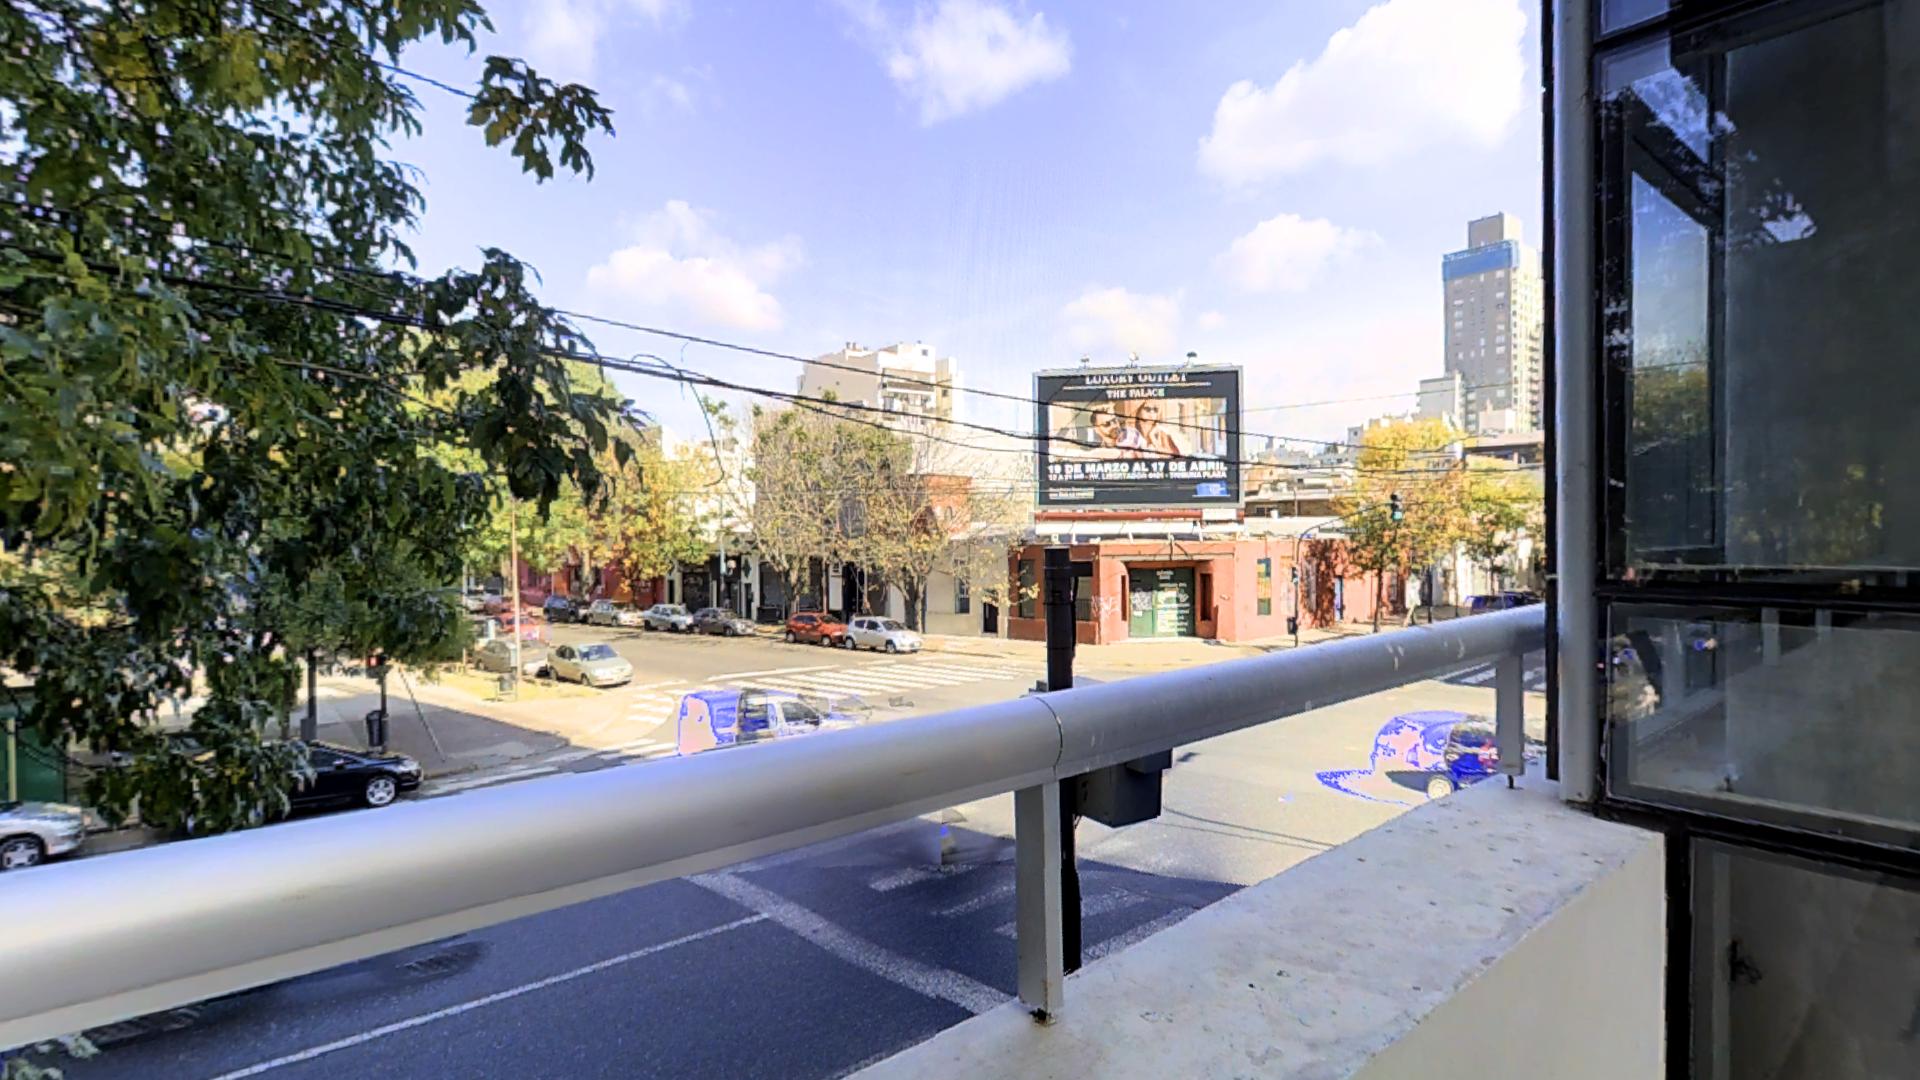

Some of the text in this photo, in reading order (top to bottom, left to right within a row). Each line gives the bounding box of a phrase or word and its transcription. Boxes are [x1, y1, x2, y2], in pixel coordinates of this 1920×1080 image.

[1085, 372, 1187, 385] LUXURY OUTLET
[1105, 387, 1165, 399] THE PALACE
[1064, 463, 1083, 474] DE
[1085, 462, 1130, 473] MARZO
[1132, 462, 1149, 472] AL
[1151, 461, 1165, 472] 17
[1168, 461, 1187, 472] DE
[1189, 460, 1228, 471] ABRIL
